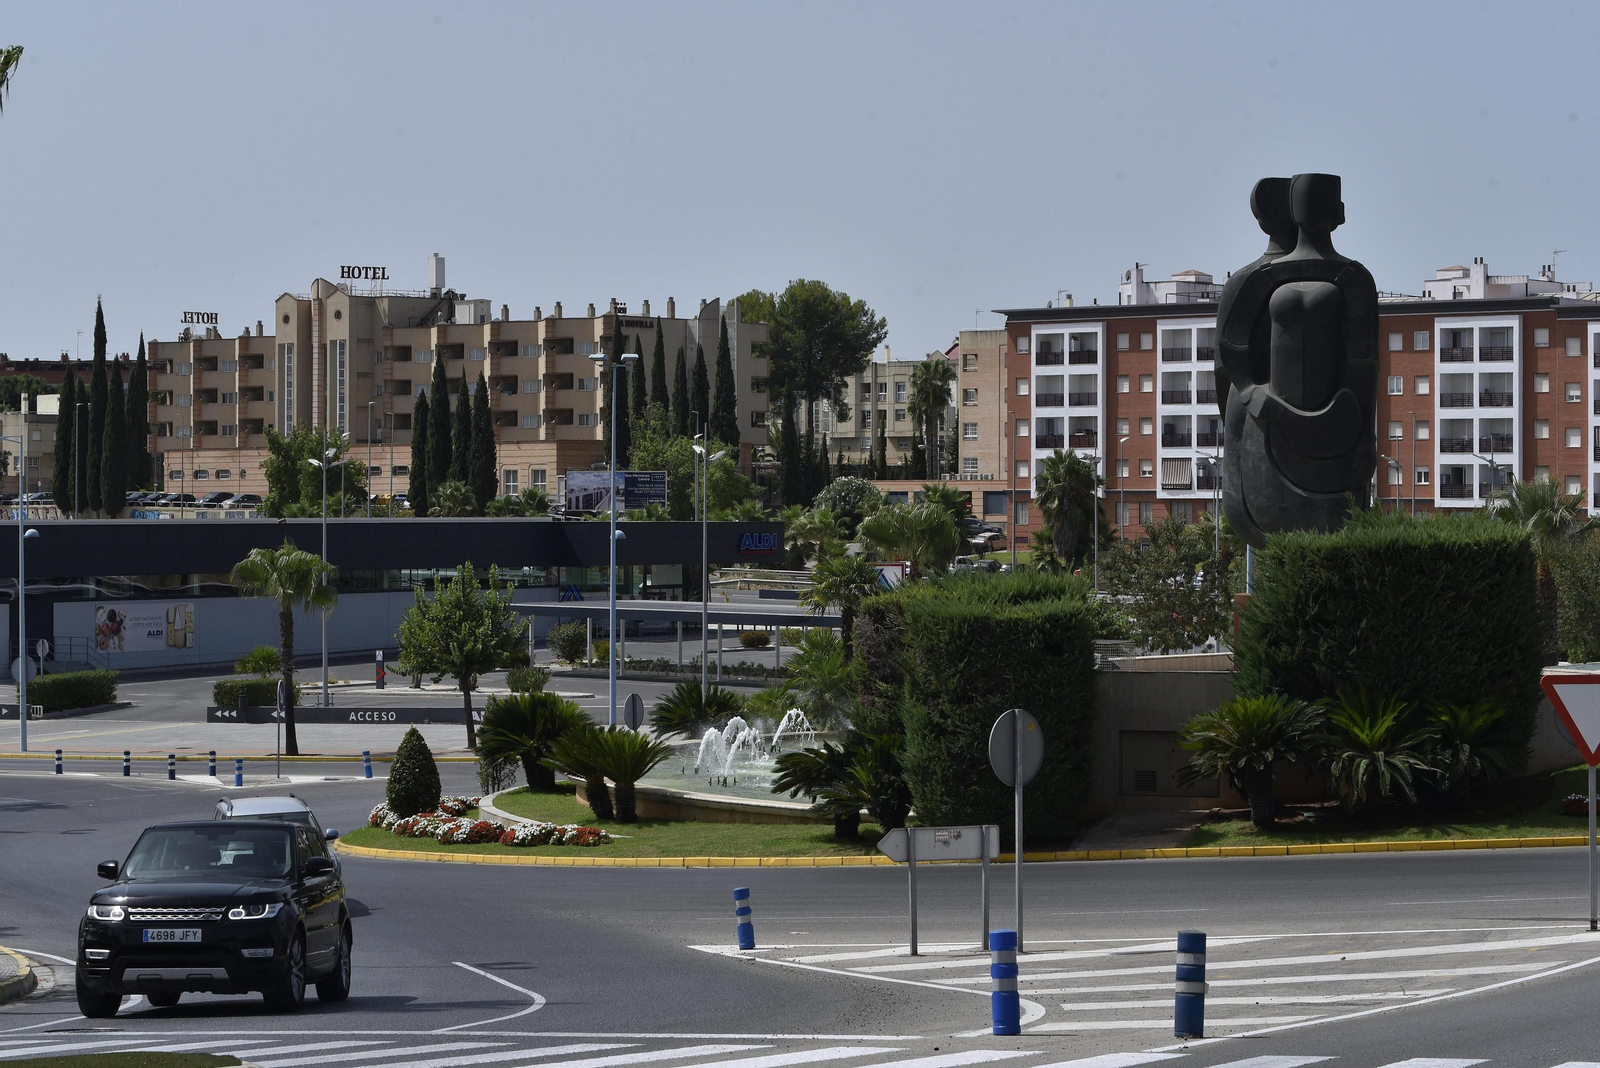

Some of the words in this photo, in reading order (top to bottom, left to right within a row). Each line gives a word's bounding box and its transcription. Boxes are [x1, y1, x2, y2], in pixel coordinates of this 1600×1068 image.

[339, 265, 390, 280] HOTEL
[740, 532, 778, 550] ALDI
[147, 629, 163, 637] ALDI
[349, 711, 397, 721] ACCESO
[149, 930, 176, 941] 4698
[178, 930, 198, 941] JFY
